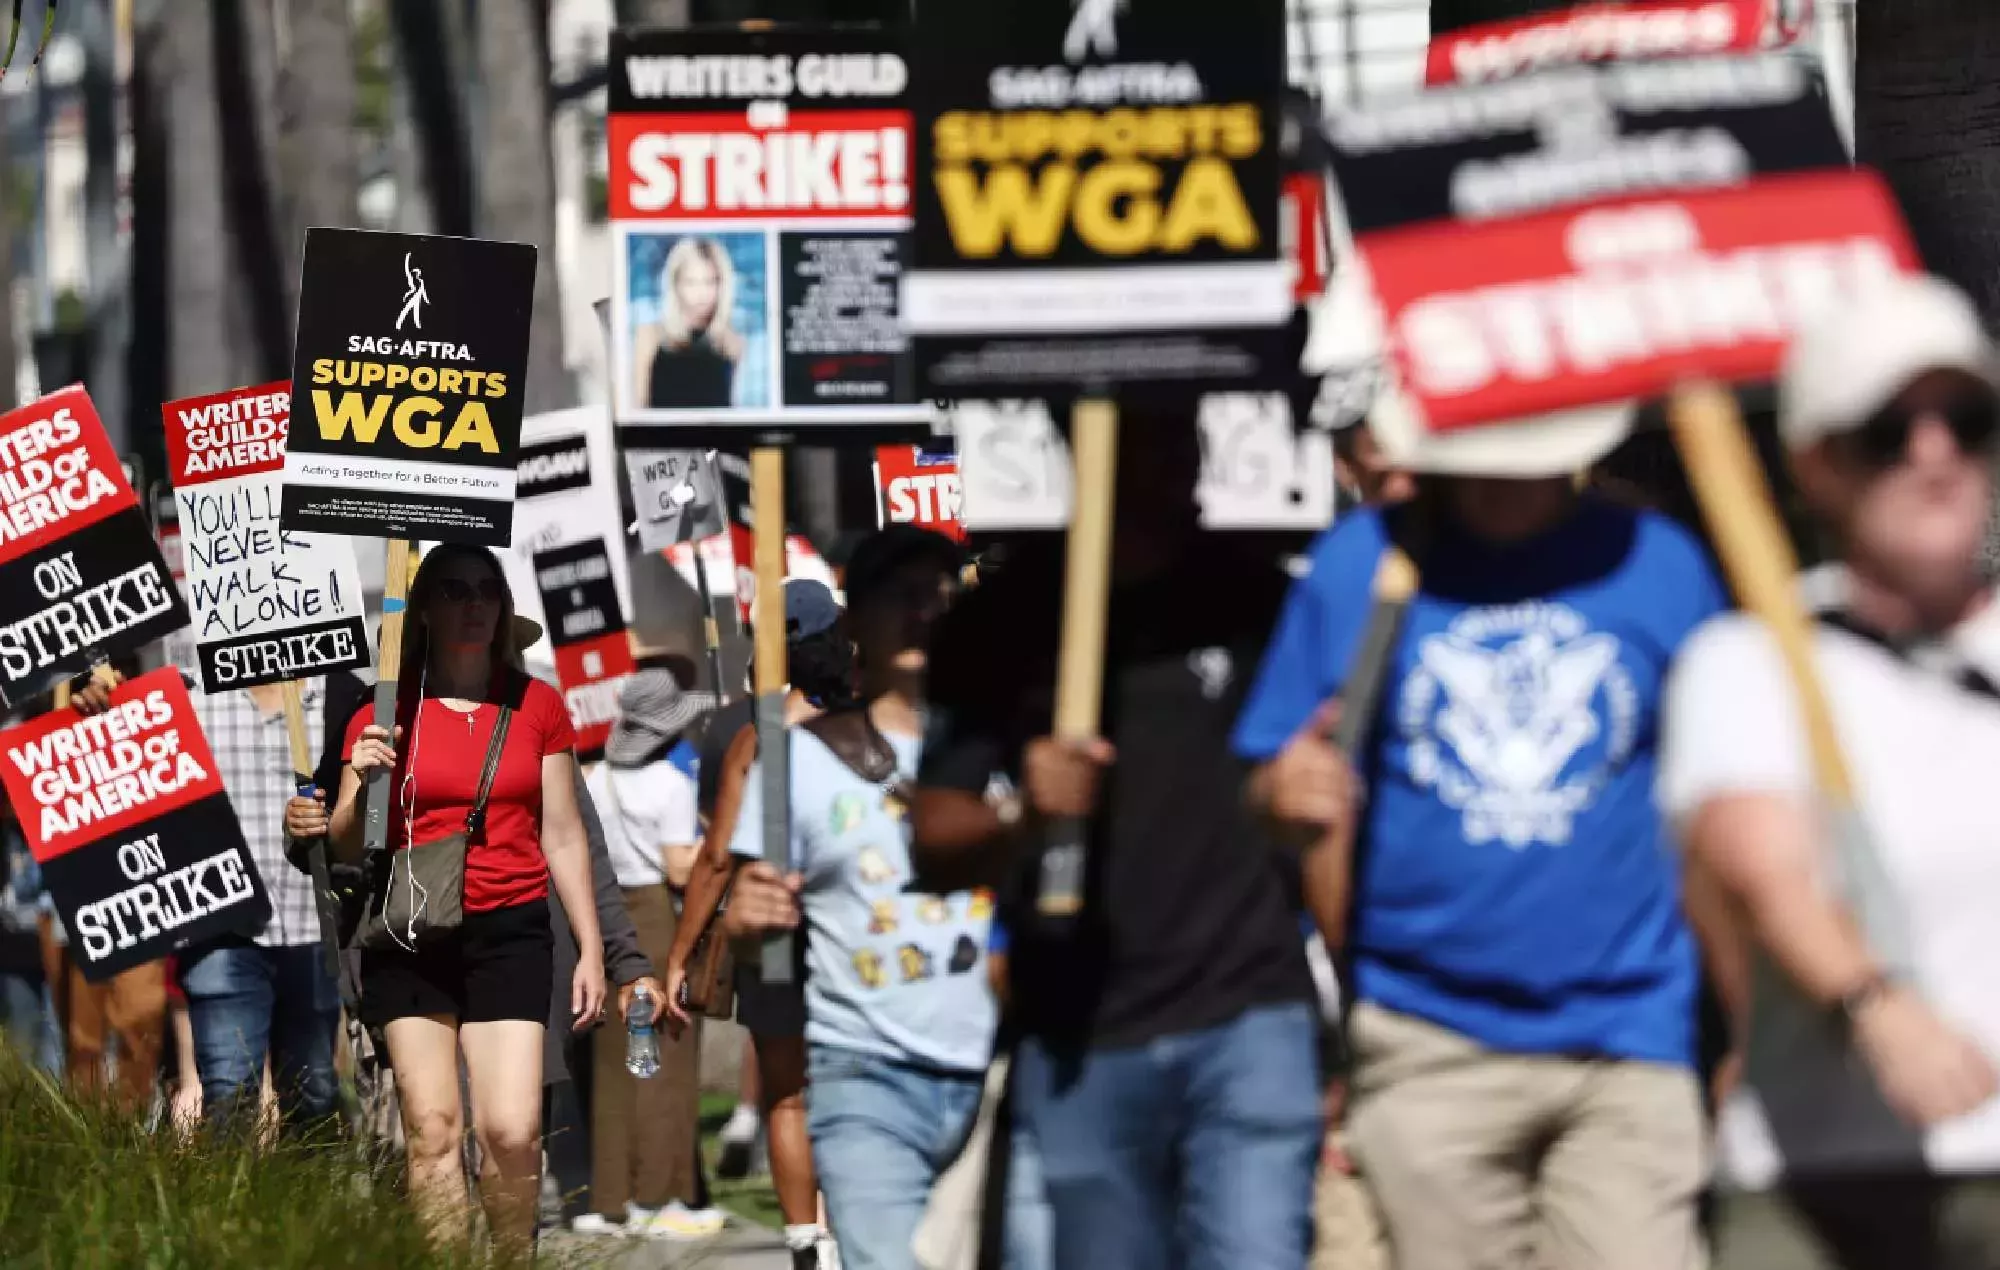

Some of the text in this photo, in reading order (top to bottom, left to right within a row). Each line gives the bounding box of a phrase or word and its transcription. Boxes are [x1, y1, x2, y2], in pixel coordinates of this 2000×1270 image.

[625, 53, 908, 97] WRITERS GUILD
[932, 103, 1263, 161] SUPPORTS
[628, 127, 910, 211] STRIKE!
[935, 157, 1260, 258] WGA
[311, 359, 507, 398] SUPPORTS
[0, 408, 81, 468] TERS
[178, 392, 289, 430] WRITER
[186, 418, 275, 451] GUILD
[311, 390, 500, 453] WGA
[0, 460, 53, 504] ILD
[301, 464, 339, 478] Acting
[343, 467, 392, 481] Together
[395, 470, 411, 482] for
[424, 473, 458, 485] Better
[462, 477, 499, 489] Future
[0, 468, 118, 546] MERICA
[181, 484, 280, 537] YOU'LL
[34, 551, 83, 600] ON
[189, 526, 312, 571] NEVER
[193, 560, 302, 611] WALK
[0, 561, 172, 681] STRIKE
[214, 627, 357, 684] STRIKE
[9, 690, 173, 777] WRITERS
[31, 741, 142, 805] GUILD
[41, 752, 207, 842] AMERICA
[117, 833, 166, 881] ON
[76, 848, 254, 962] STRIKE
